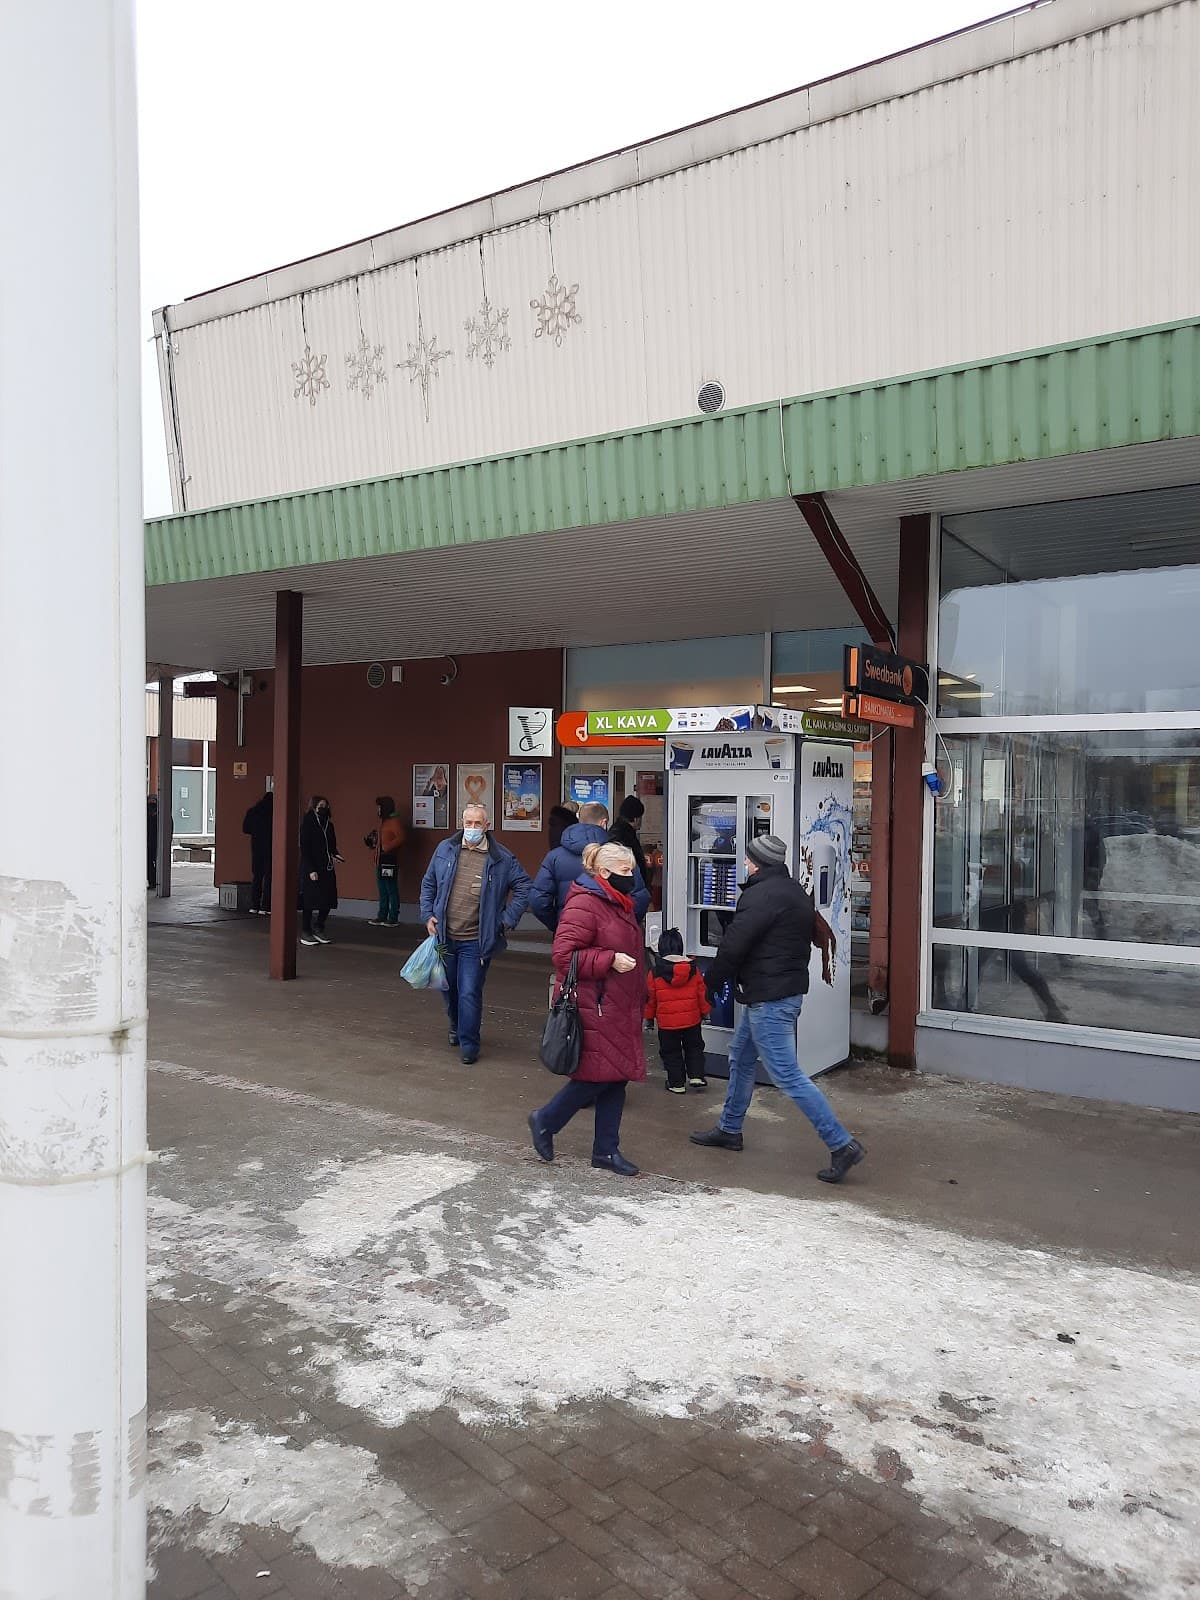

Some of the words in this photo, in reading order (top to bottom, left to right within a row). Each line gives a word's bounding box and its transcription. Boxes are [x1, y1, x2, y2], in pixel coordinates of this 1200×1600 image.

[864, 659, 903, 687] Swedbank
[863, 701, 895, 719] BANKOMATAS
[596, 716, 613, 729] XL
[617, 715, 658, 729] KAVA
[805, 718, 812, 729] XL
[701, 743, 753, 759] LAVAZZA
[812, 756, 844, 778] LAVAZZA
